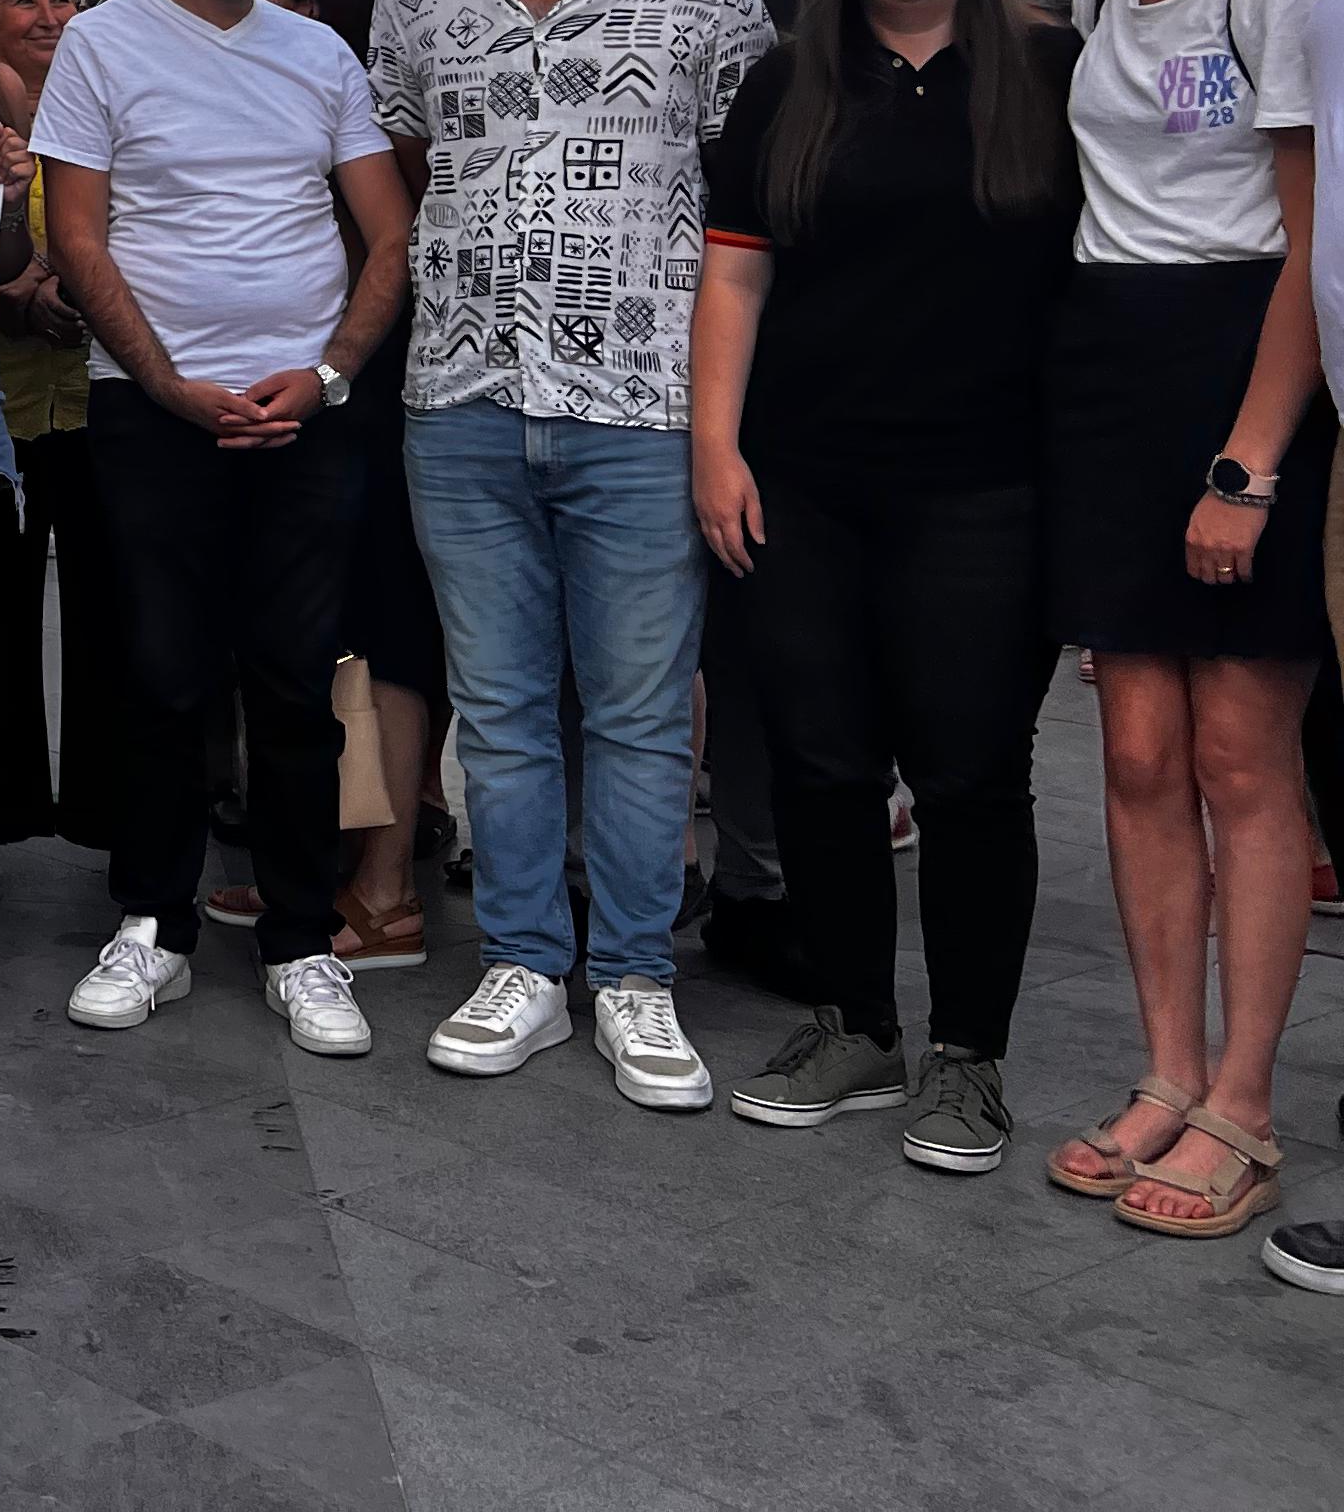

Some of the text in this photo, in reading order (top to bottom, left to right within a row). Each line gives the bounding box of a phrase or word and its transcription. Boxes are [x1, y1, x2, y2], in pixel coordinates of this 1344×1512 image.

[1162, 55, 1233, 83] NEW
[1158, 75, 1238, 111] YORK
[1206, 105, 1235, 129] 28
